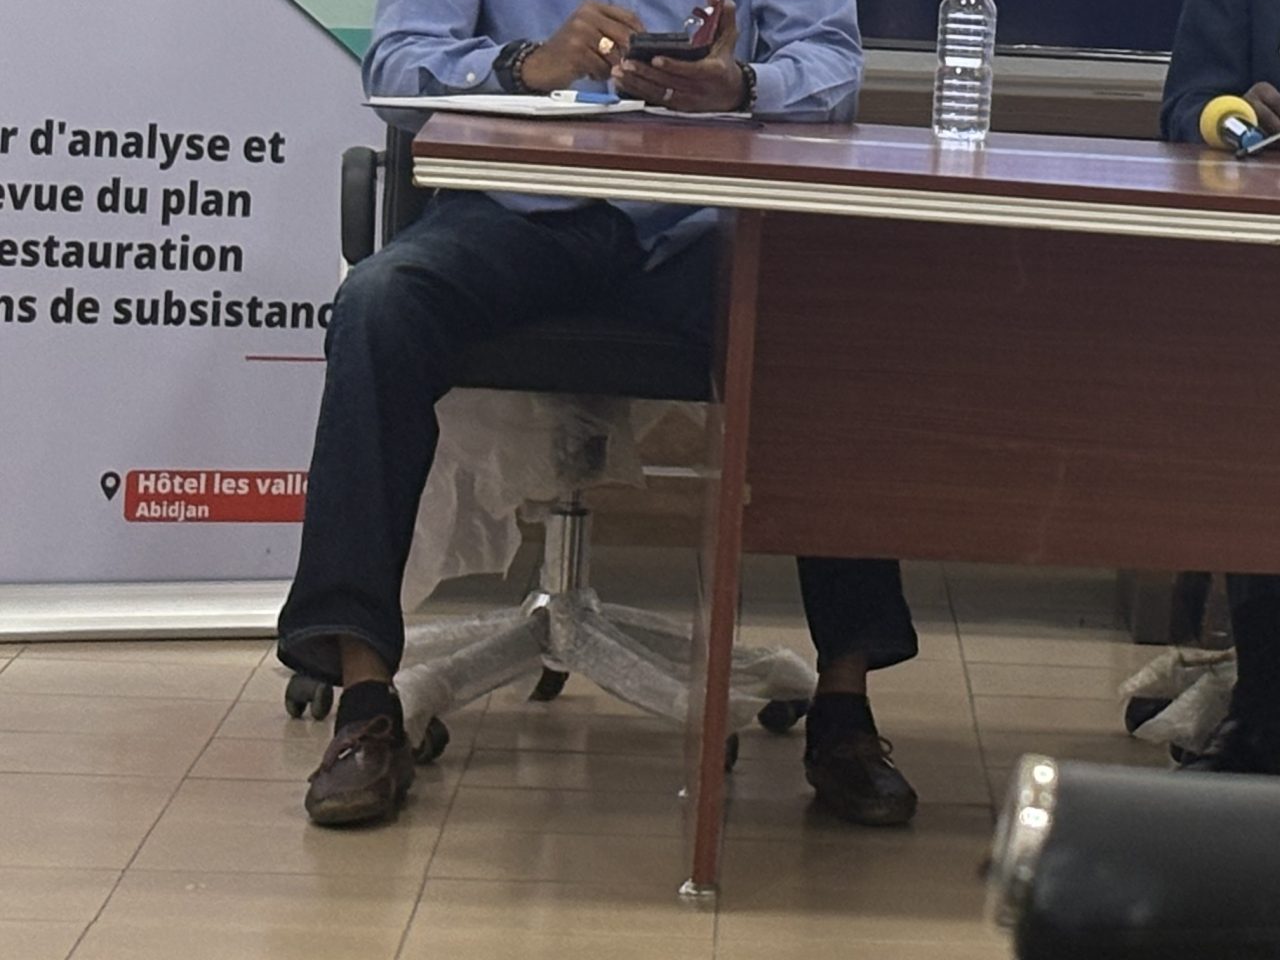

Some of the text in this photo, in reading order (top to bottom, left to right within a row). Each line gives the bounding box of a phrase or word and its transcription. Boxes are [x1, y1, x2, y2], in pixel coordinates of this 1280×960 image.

[30, 119, 230, 170] d'analyse
[243, 131, 286, 164] et
[97, 176, 148, 214] du
[161, 180, 251, 226] plan
[0, 234, 243, 272] estauration
[50, 287, 100, 324] de
[113, 289, 336, 329] subsistanc
[138, 472, 308, 495] Hôtel les vall
[136, 501, 209, 522] Abidjan
